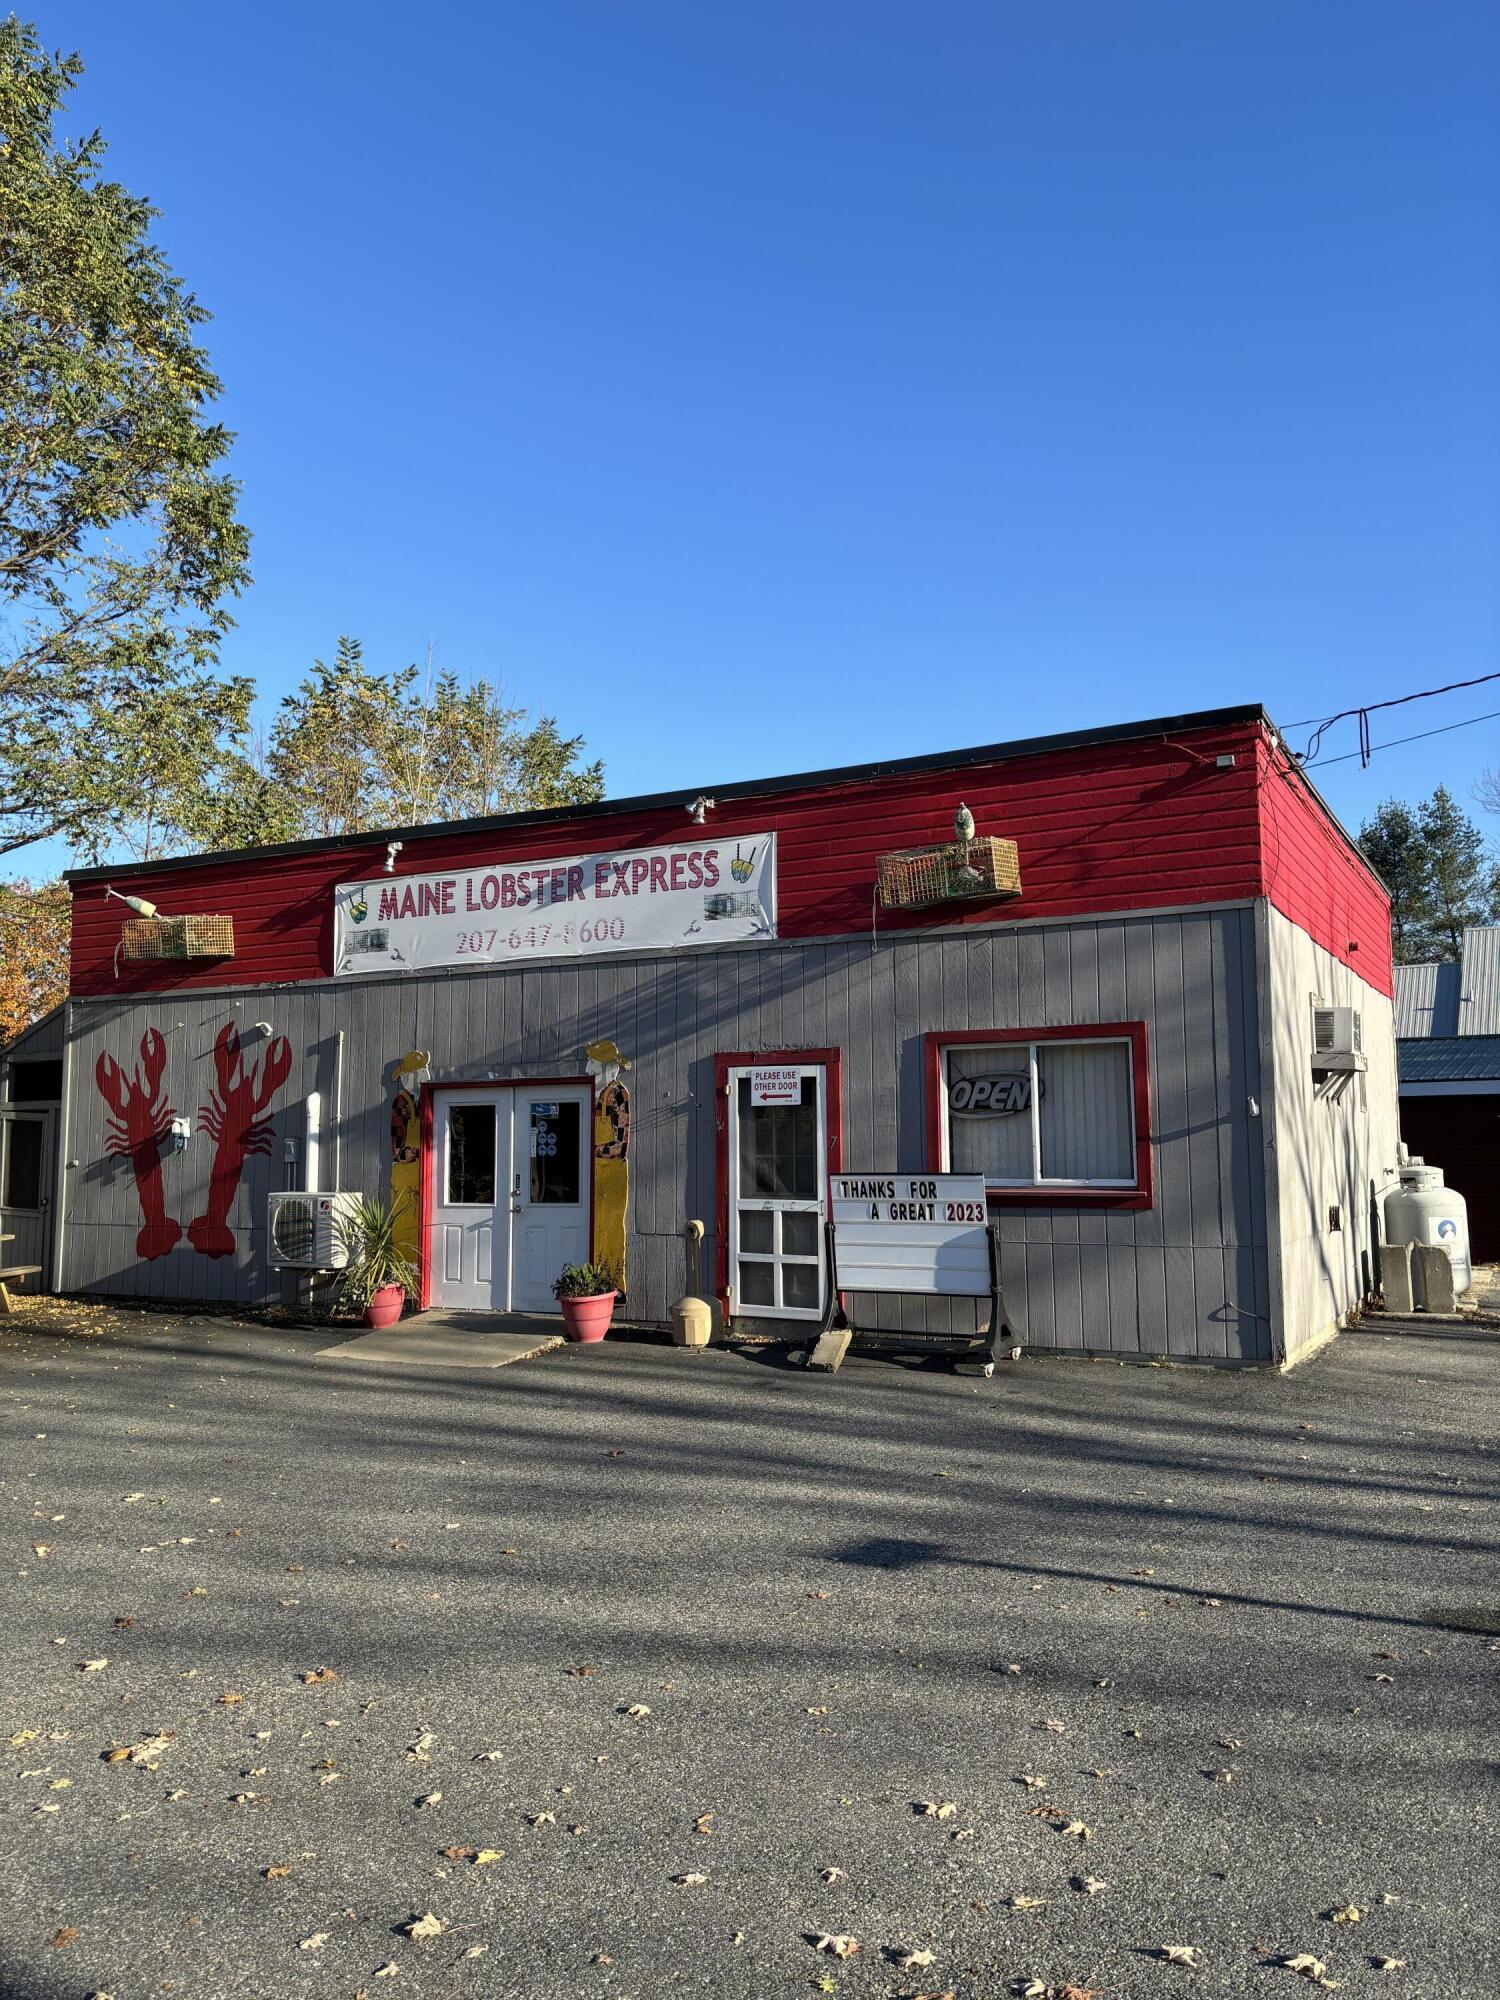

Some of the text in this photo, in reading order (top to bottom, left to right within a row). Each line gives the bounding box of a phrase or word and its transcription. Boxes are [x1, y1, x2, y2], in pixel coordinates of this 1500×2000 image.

[378, 849, 720, 921] MAINE LOBSTER EXPRESS
[755, 1071, 797, 1081] PLEASE USE
[754, 1081, 798, 1092] OTHER DOOR
[950, 1080, 1032, 1111] OPEN
[841, 1180, 938, 1199] THANKS FOR
[871, 1202, 985, 1222] A GREAT 2023
